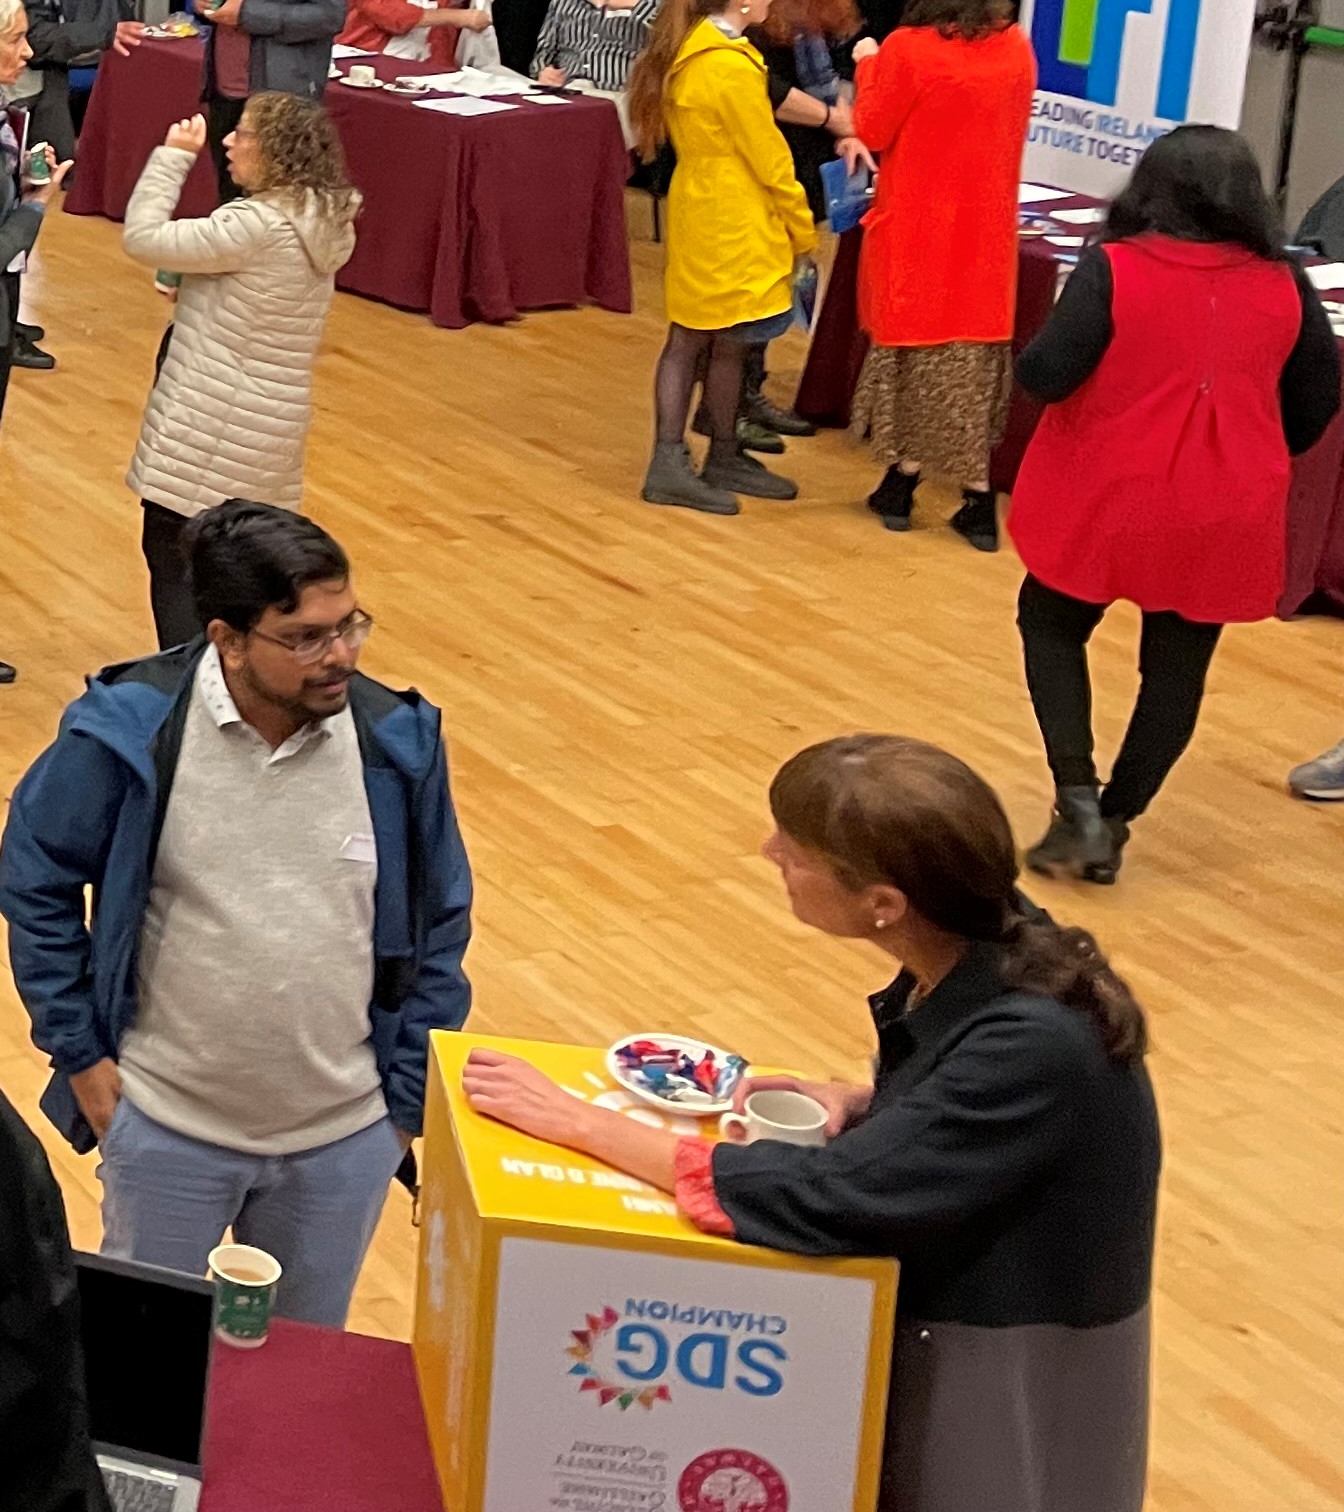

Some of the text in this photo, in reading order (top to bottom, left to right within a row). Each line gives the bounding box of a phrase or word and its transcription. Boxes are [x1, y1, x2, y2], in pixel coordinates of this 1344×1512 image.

[1030, 98, 1094, 129] EADING
[1026, 124, 1145, 167] UTURE TOGET
[624, 1296, 788, 1336] CHAMPION
[615, 1321, 789, 1398] SDG
